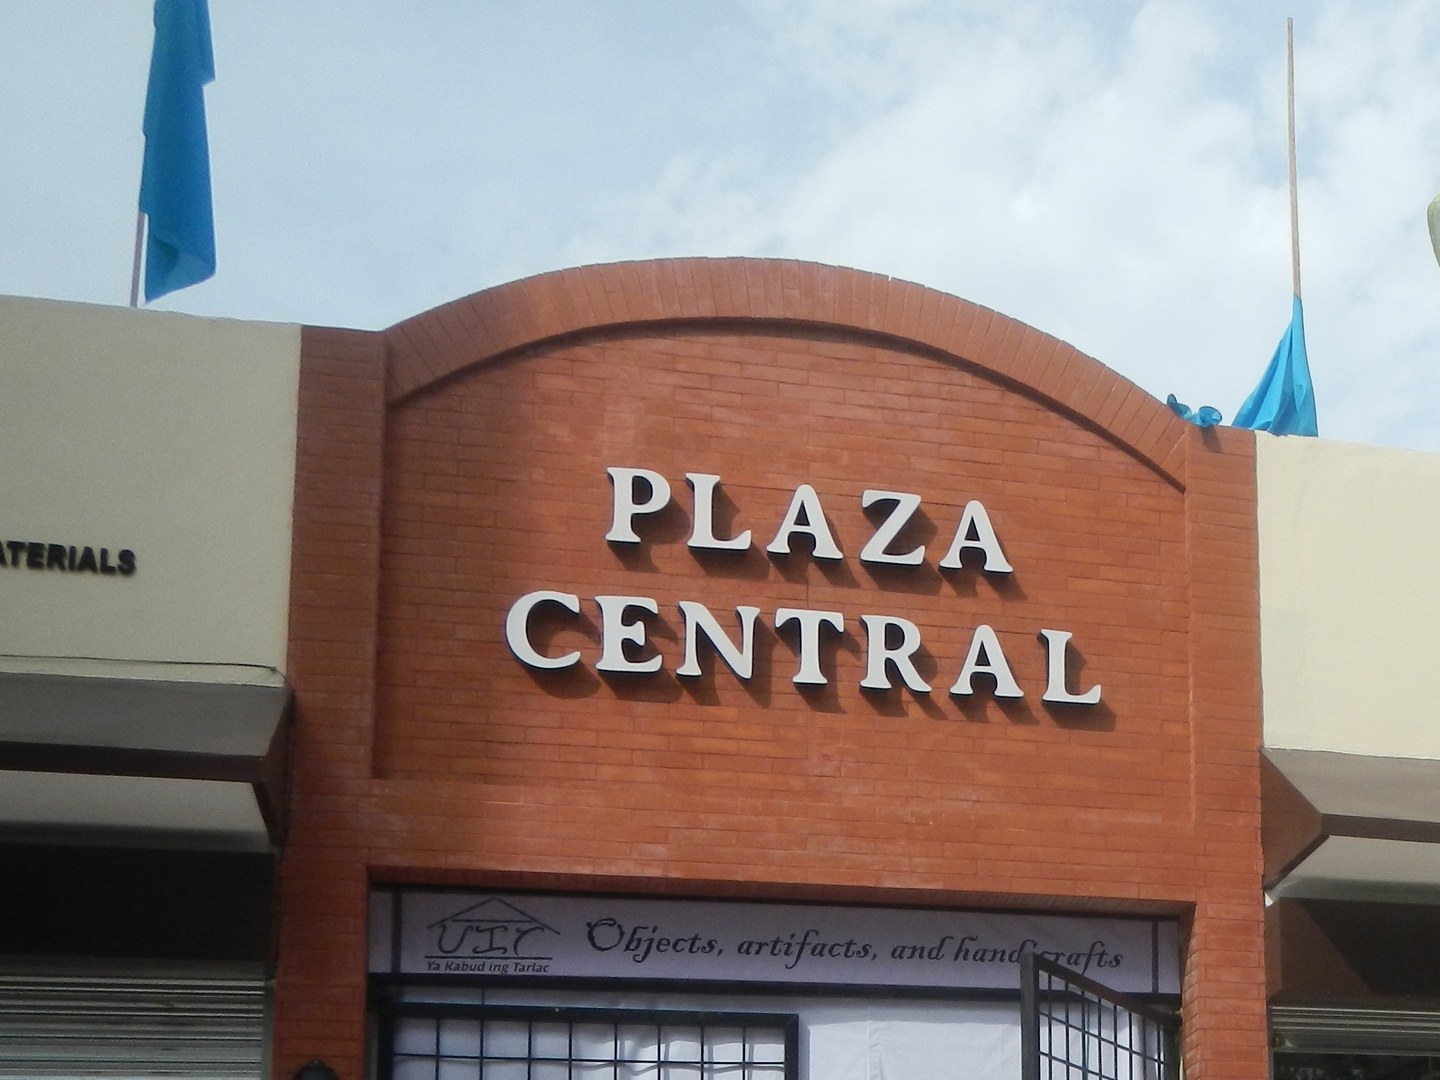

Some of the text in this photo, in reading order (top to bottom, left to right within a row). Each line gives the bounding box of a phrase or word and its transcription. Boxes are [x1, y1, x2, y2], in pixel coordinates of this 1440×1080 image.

[605, 466, 1014, 574] PLAZA
[505, 590, 1102, 706] CENTRAL
[426, 960, 550, 974] Ya Kabud ing Tarlac
[586, 917, 724, 963] Objects,
[737, 928, 879, 969] artifacts,
[891, 935, 953, 961] and
